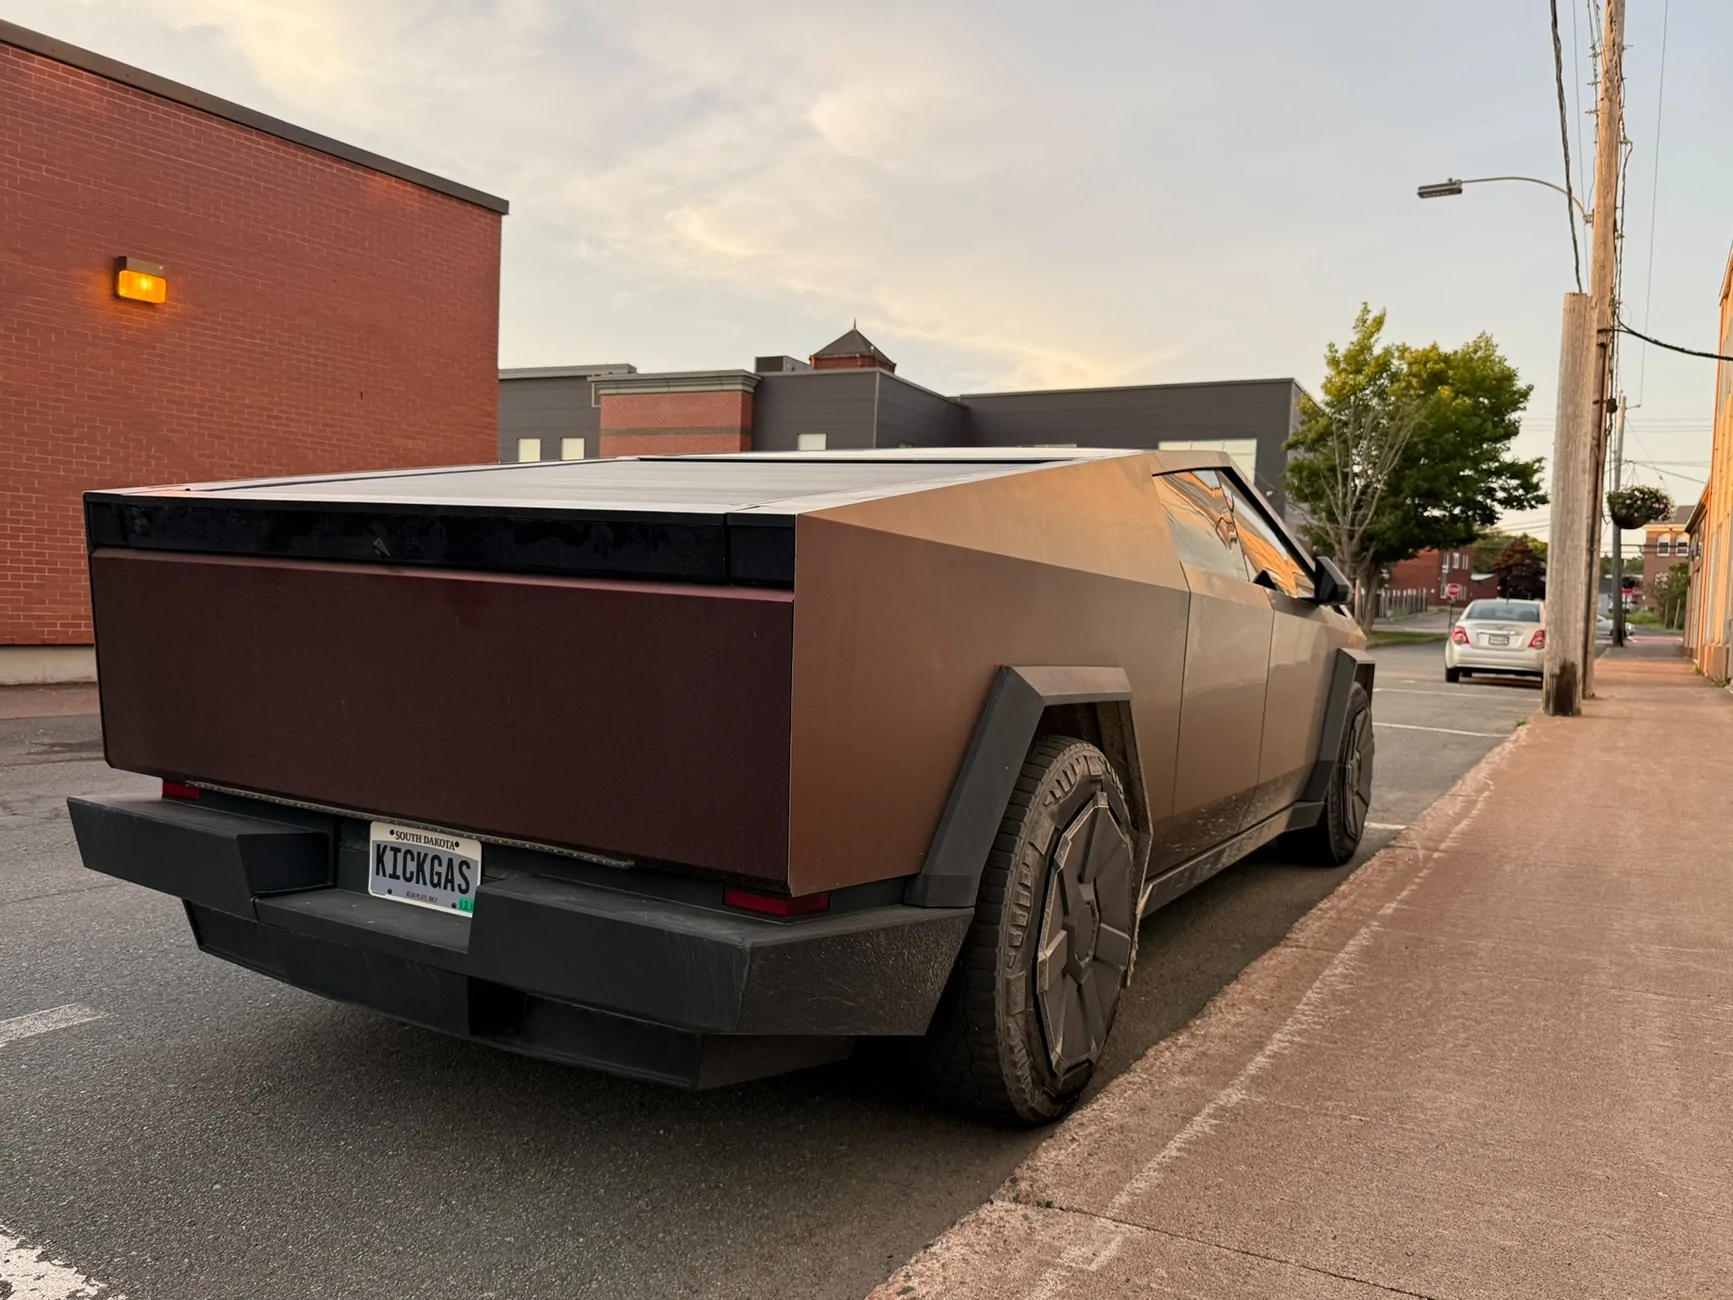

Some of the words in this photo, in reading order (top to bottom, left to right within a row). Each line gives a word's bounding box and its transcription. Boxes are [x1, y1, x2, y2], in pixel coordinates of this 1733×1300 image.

[395, 830, 422, 844] SOUTH
[423, 835, 456, 851] DAKOTA
[375, 843, 471, 895] KICKGAS
